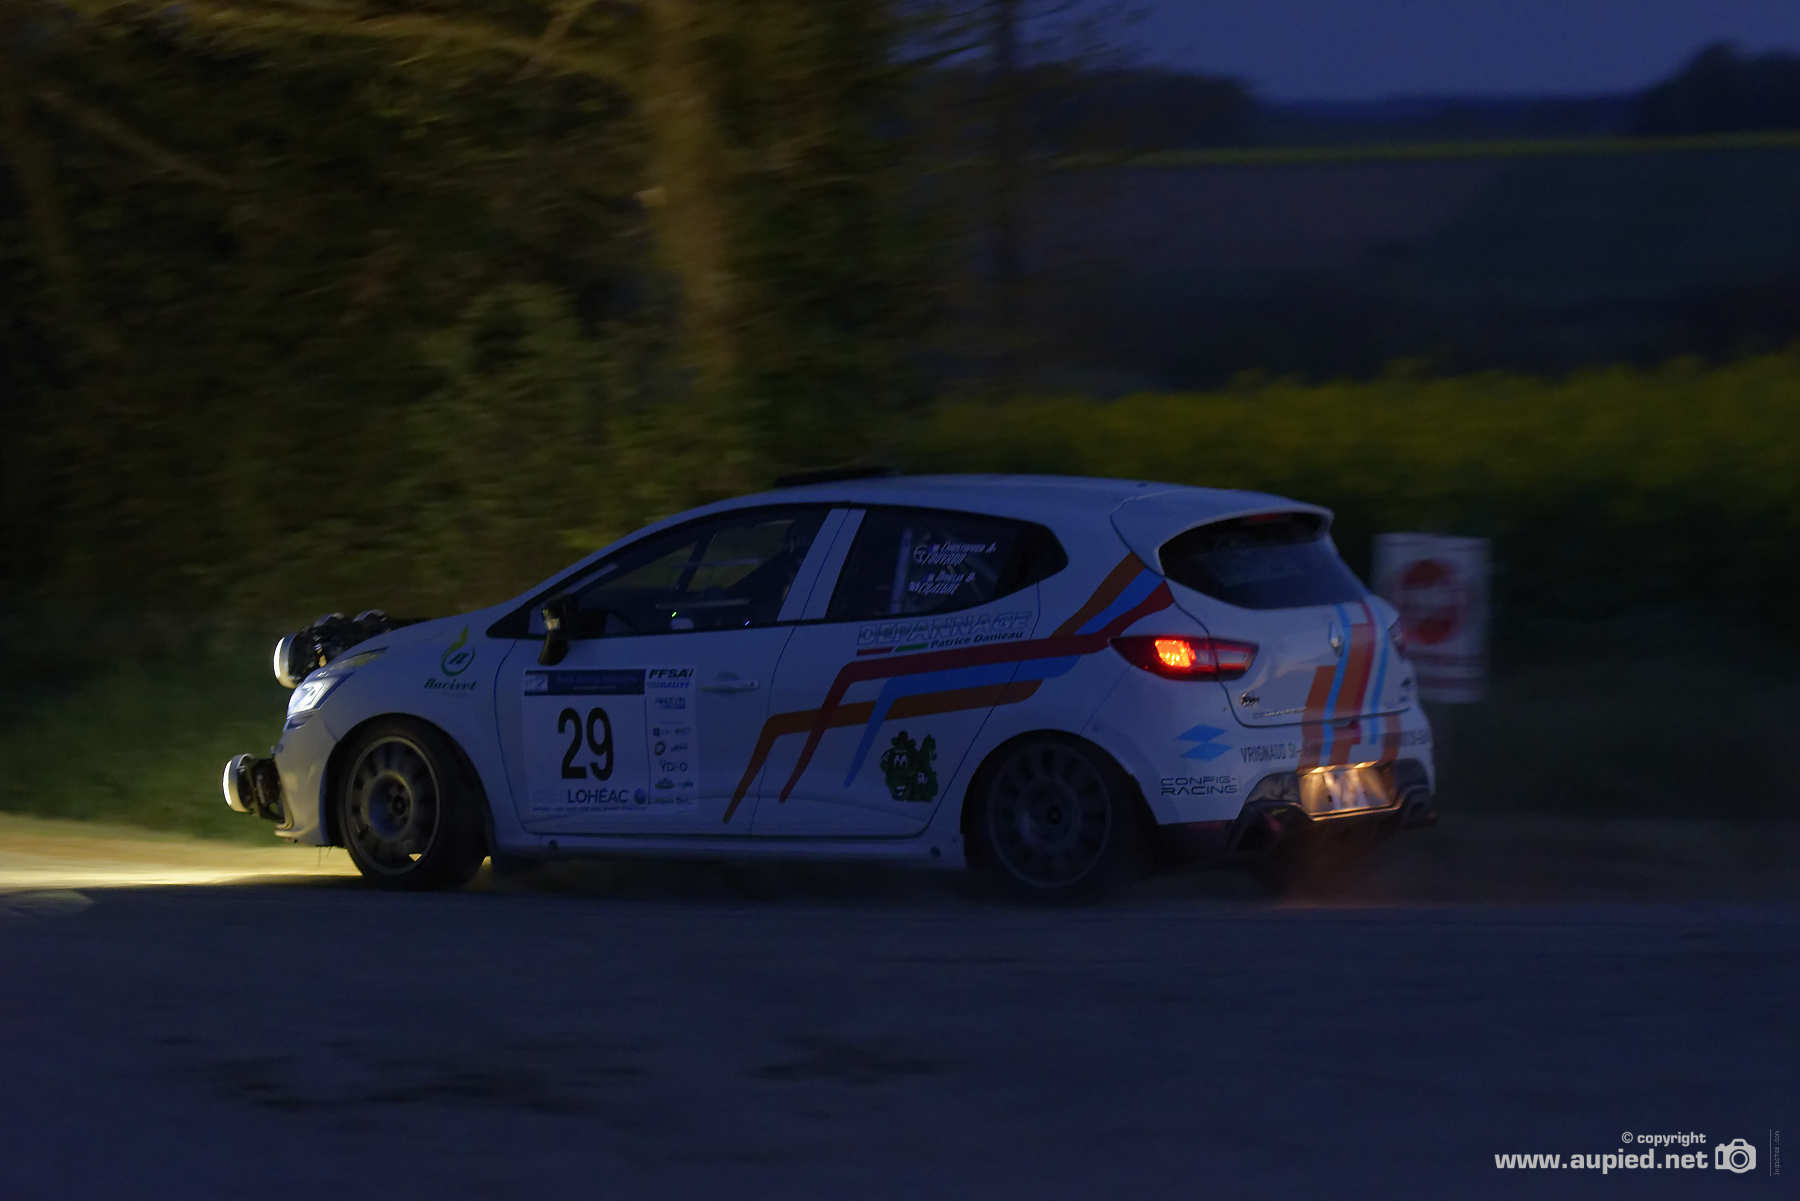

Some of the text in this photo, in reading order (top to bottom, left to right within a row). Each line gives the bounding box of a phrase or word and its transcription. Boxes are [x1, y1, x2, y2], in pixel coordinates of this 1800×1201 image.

[557, 706, 614, 781] 29
[567, 788, 628, 804] LOHÉAC
[1160, 784, 1238, 796] RACING
